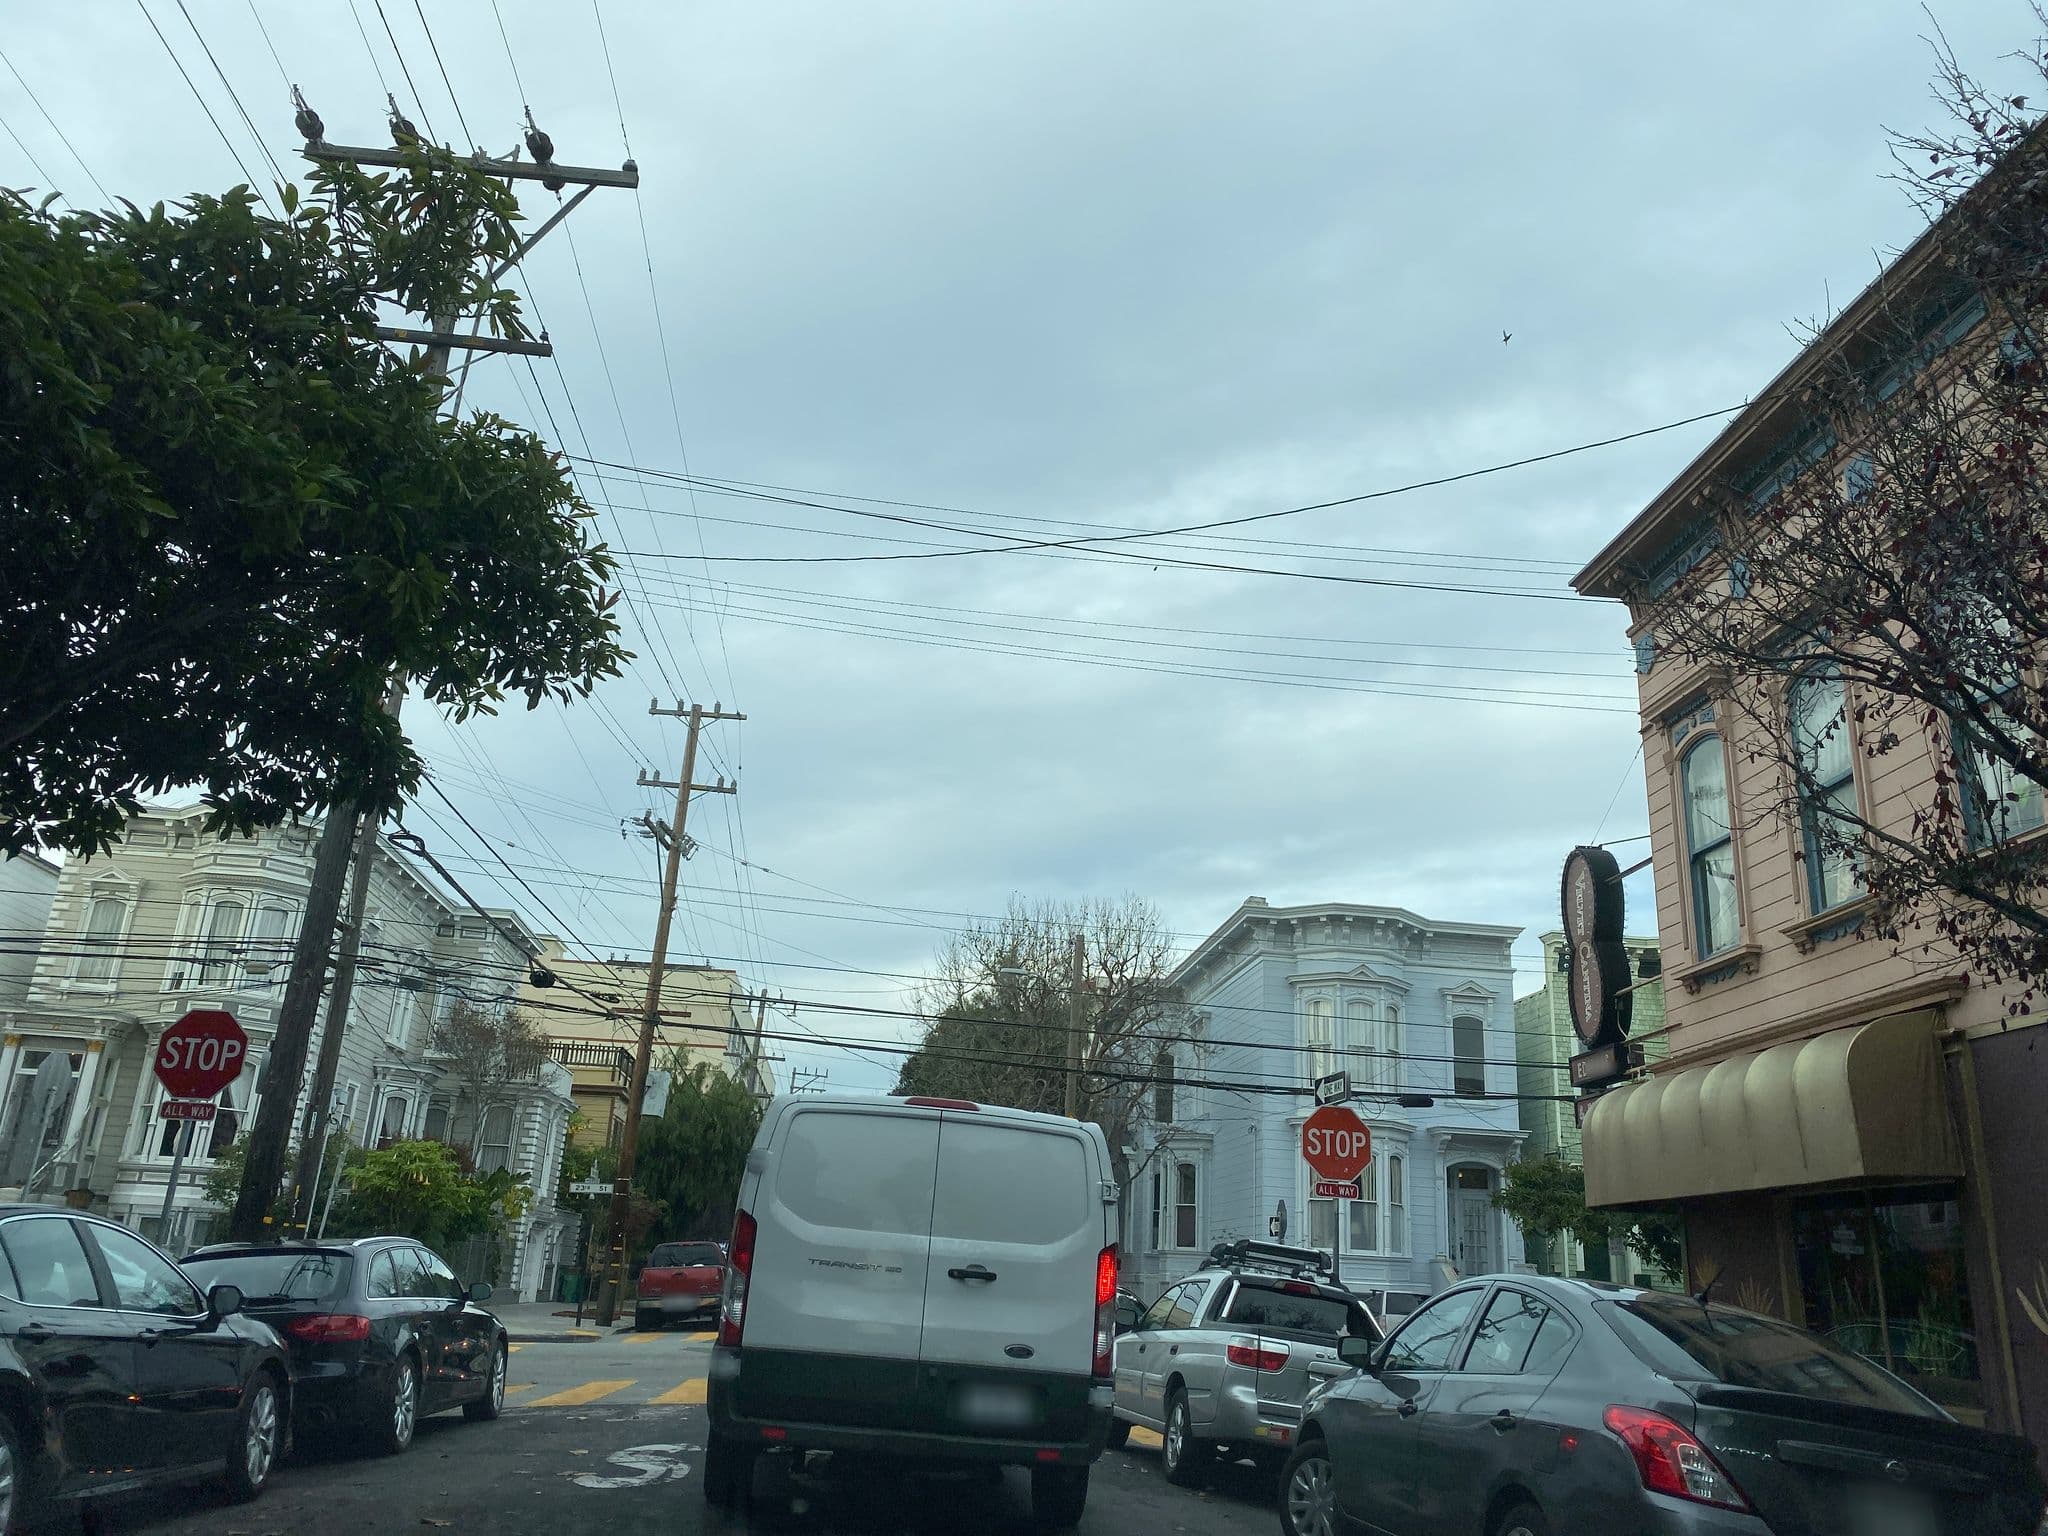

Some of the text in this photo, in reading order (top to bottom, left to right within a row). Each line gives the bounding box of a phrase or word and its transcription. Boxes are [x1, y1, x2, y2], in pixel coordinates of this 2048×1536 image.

[1579, 941, 1592, 1023] CANTINA
[160, 1036, 242, 1072] STOP
[163, 1103, 212, 1118] ALL WAY
[1306, 1127, 1367, 1158] STOP
[1318, 1185, 1356, 1197] ALL WAY
[808, 1258, 882, 1273] TRANSIT
